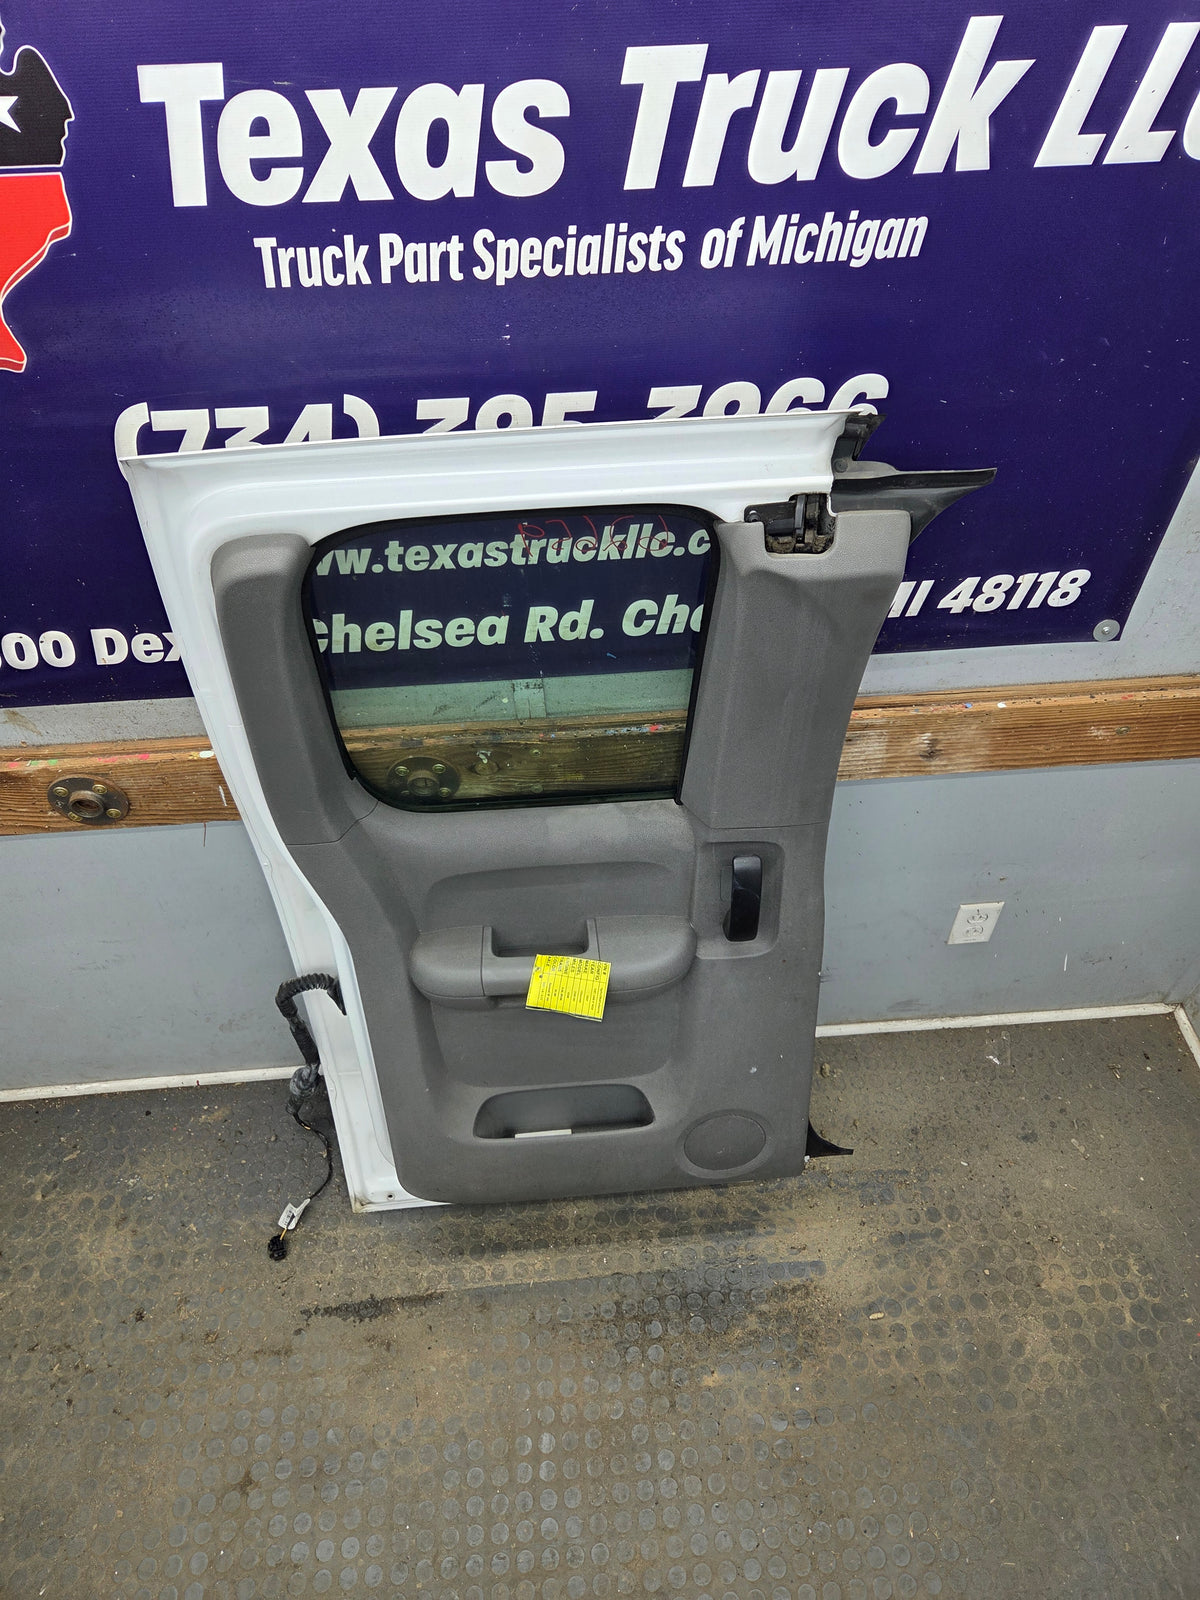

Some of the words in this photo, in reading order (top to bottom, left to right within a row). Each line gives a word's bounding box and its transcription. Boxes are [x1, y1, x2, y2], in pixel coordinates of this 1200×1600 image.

[137, 62, 570, 207] Texas
[621, 15, 1036, 190] Truck
[1033, 21, 1200, 168] LL
[253, 235, 371, 289] Truck
[379, 232, 464, 284] Part
[473, 223, 686, 286] Specialists
[700, 216, 746, 270] of
[746, 209, 929, 268] Michigan
[0, 630, 76, 670] 00
[524, 599, 604, 643] Rd.
[937, 569, 1092, 614] 48118
